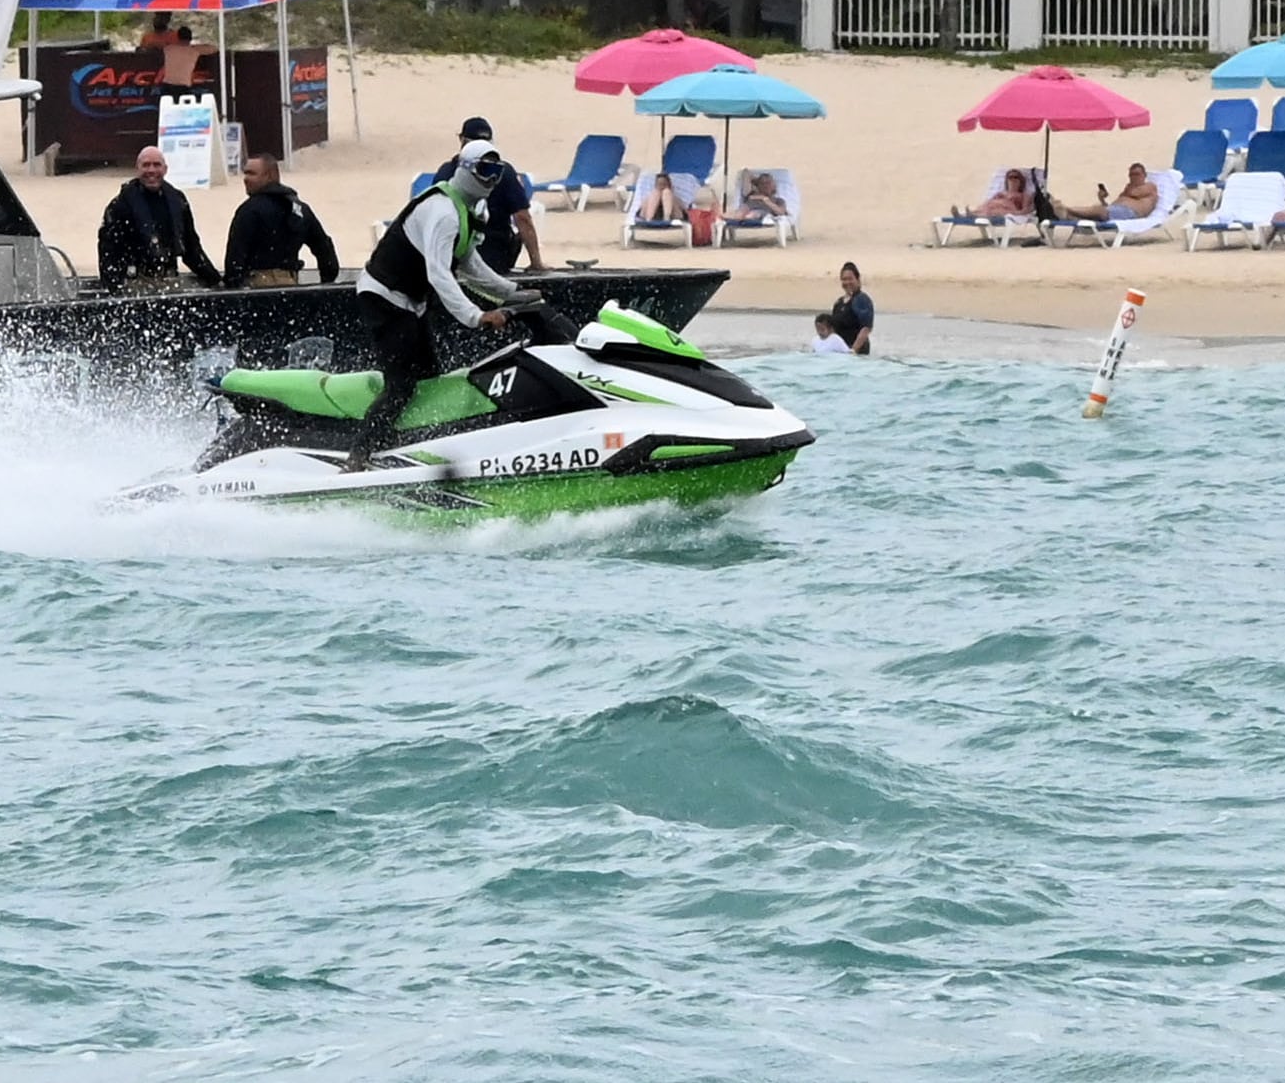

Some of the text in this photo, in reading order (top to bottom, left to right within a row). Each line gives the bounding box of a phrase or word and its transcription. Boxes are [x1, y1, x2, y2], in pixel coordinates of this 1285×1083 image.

[488, 366, 518, 398] 47
[577, 371, 614, 387] VX
[512, 452, 564, 474] 6234
[570, 448, 600, 467] AD
[210, 480, 256, 495] YAMAHA
